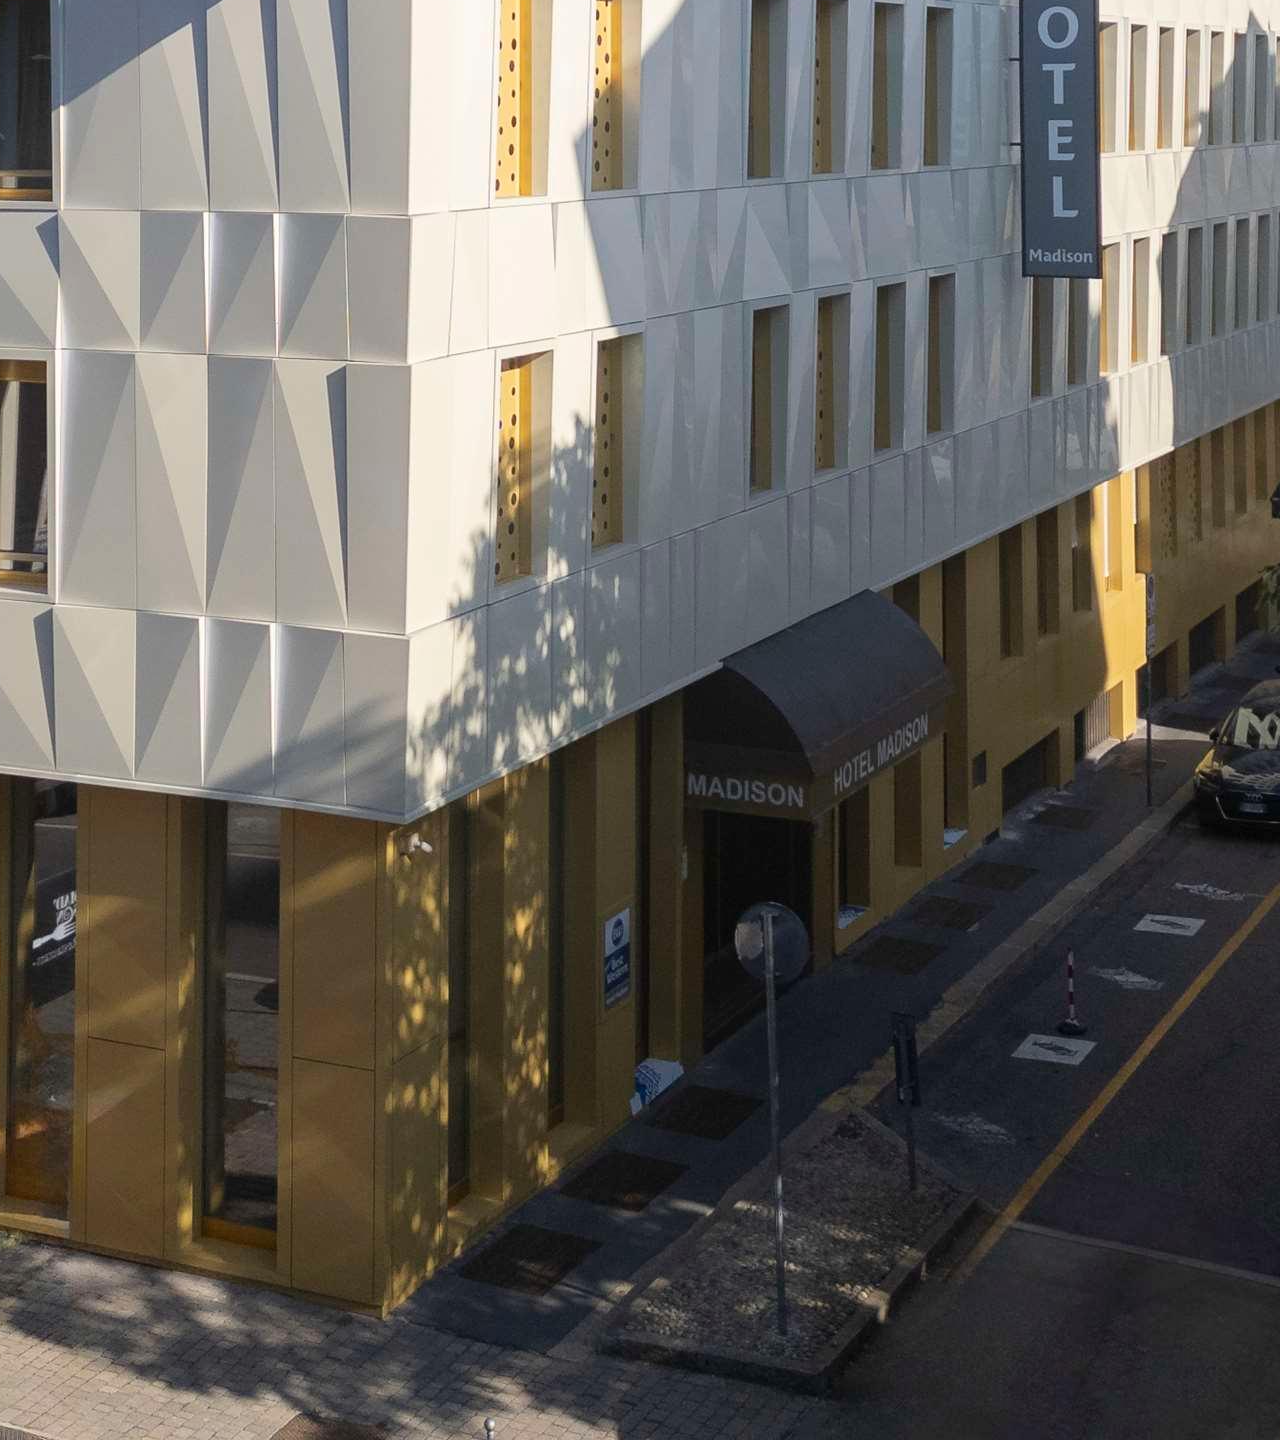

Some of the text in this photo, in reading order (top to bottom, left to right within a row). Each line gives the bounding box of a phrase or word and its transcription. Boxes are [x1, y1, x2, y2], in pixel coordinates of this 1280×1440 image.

[1029, 248, 1093, 263] Madison
[833, 711, 929, 796] HOTEL MADISON
[687, 773, 805, 808] MADISON
